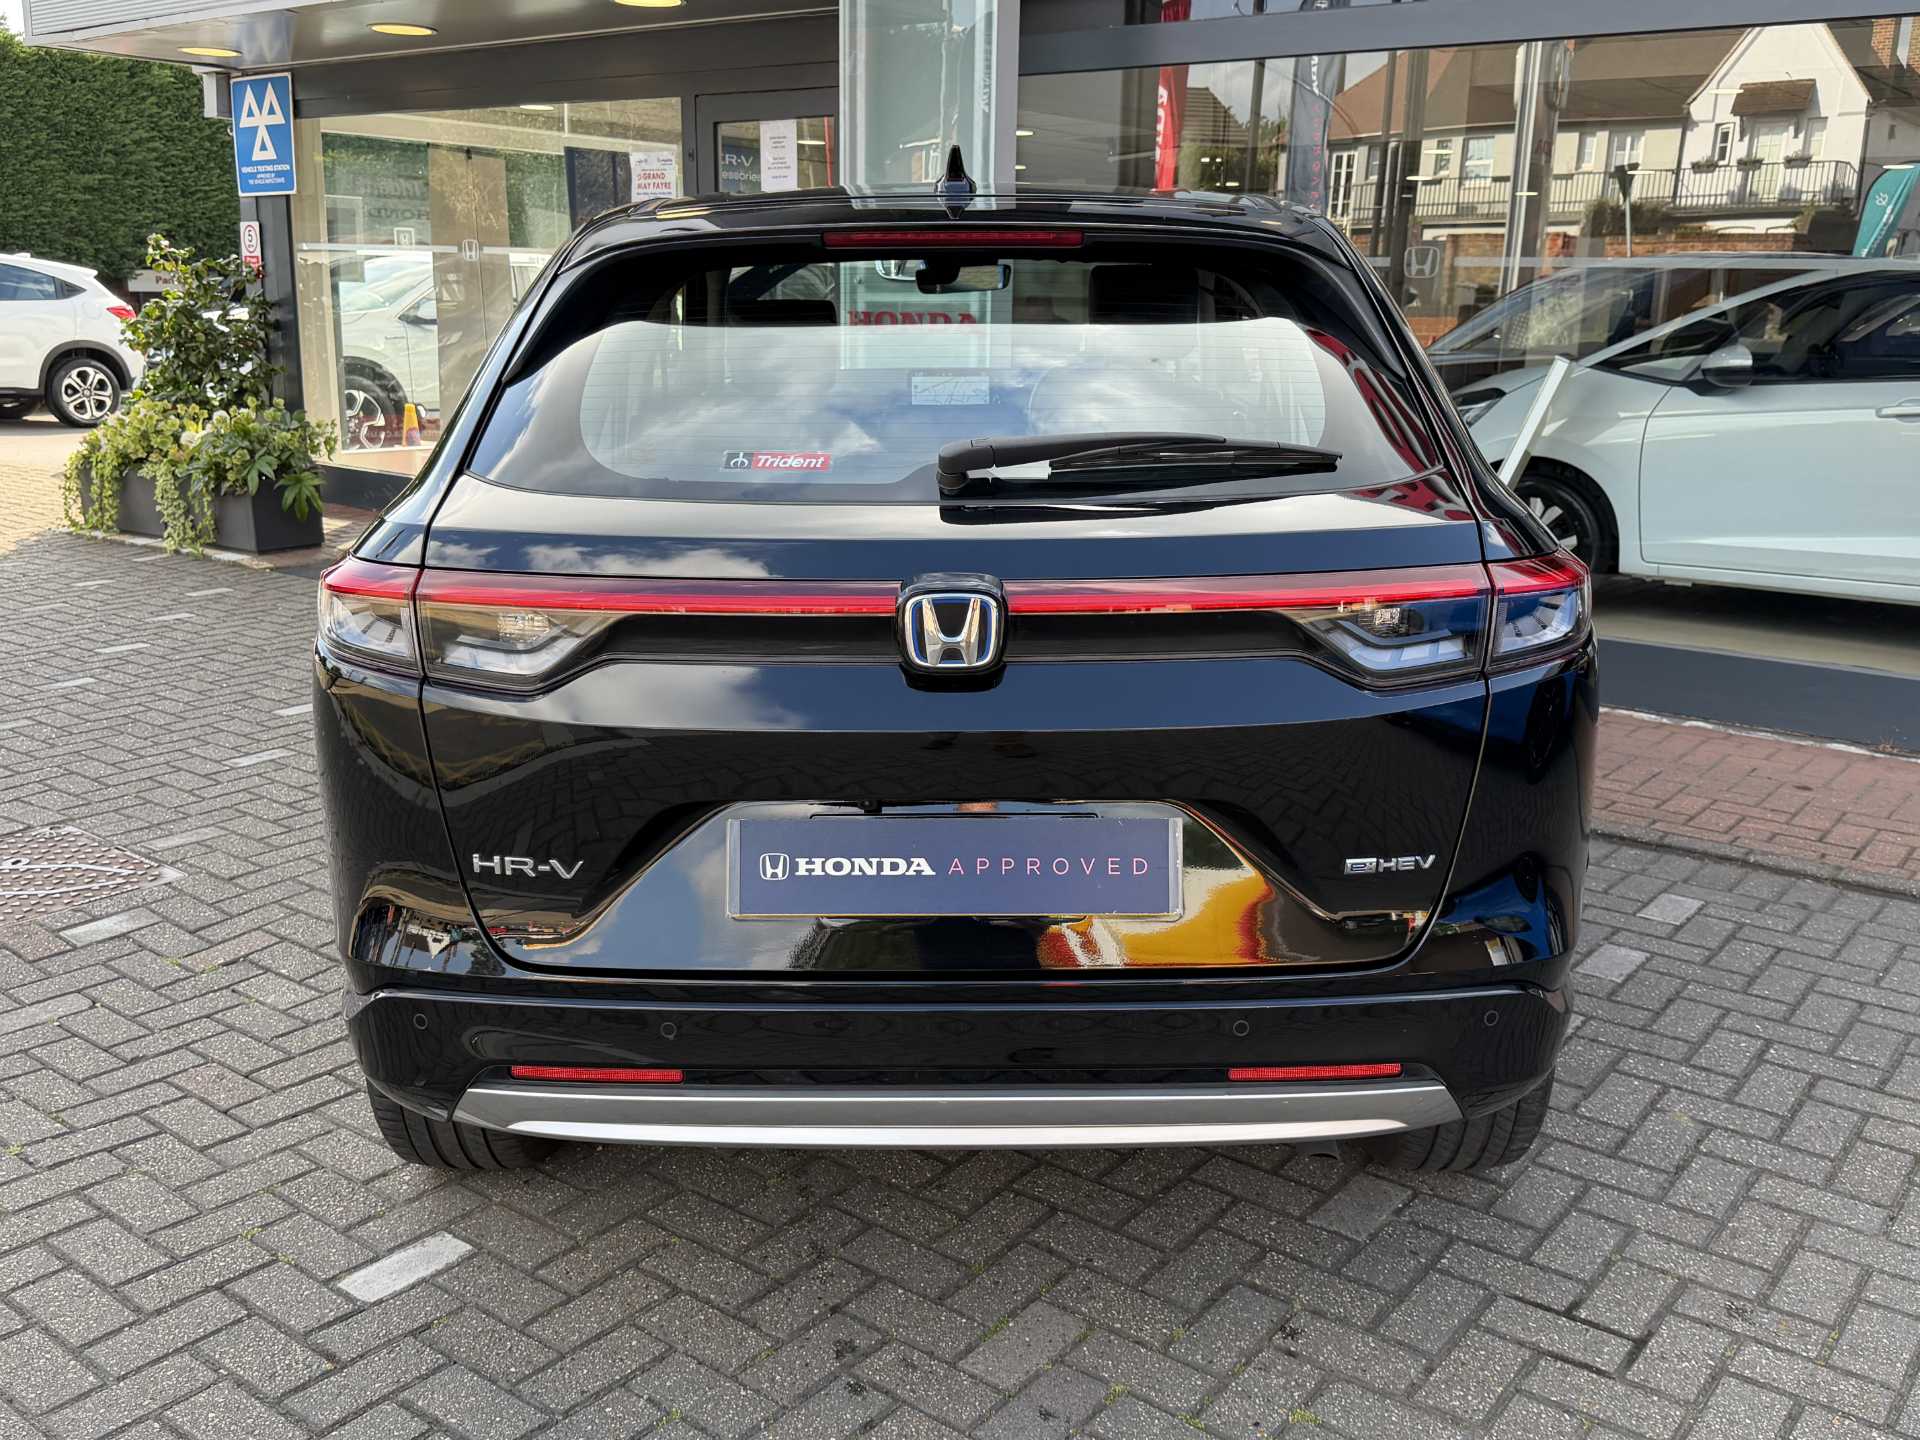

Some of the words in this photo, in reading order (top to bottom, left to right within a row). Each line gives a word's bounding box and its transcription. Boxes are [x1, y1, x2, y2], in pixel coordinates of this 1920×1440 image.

[642, 172, 665, 180] GRAND
[247, 229, 253, 243] 5
[757, 455, 825, 468] Trident
[472, 853, 584, 880] HR-V
[795, 857, 936, 877] HONDA
[947, 857, 1149, 876] APPROVED
